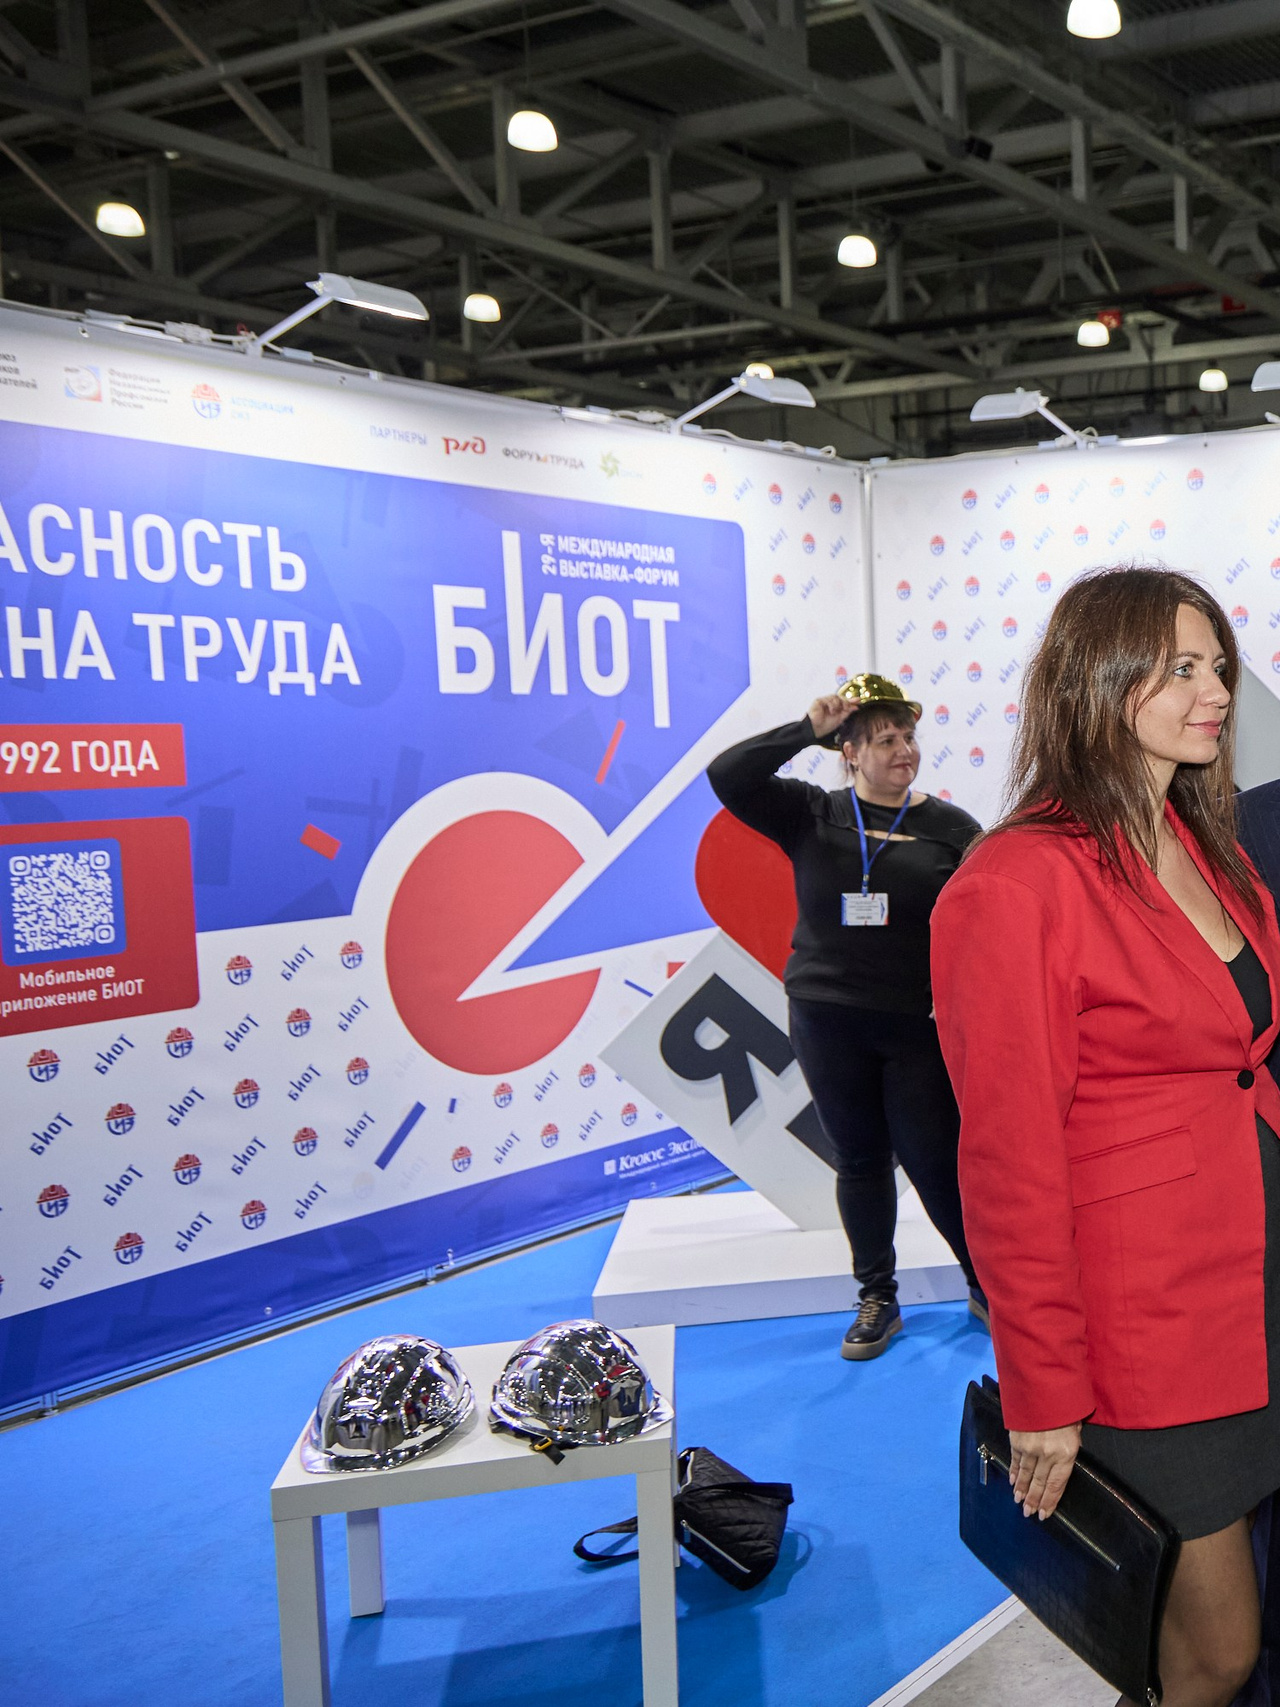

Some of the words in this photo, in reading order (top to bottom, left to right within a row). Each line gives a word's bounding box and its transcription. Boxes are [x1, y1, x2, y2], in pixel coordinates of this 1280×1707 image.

[369, 424, 428, 446] ПАРТНЕРЫ
[558, 534, 675, 564] МЕЖДУНАРОДНАЯ
[559, 560, 680, 587] ВЫСТАВКА-ФОРУМ
[432, 530, 680, 728] БИОТ
[0, 606, 116, 681] НА
[132, 612, 362, 697] ТРУДА
[71, 740, 160, 777] ГОДА
[19, 965, 116, 989] Мобильное
[281, 945, 314, 981] БИОТ
[101, 978, 145, 1000] БИОТ
[224, 1014, 259, 1052] БИОТ
[338, 997, 369, 1032] БИОТ
[94, 1035, 134, 1075] БИОТ
[288, 1065, 321, 1101] БИОТ
[167, 1087, 205, 1126] БИОТ
[30, 1113, 72, 1156] БИОТ
[344, 1112, 375, 1148] БИОТ
[231, 1137, 266, 1175] БИОТ
[103, 1165, 143, 1206] БИОТ
[294, 1182, 327, 1219] БИОТ
[175, 1212, 212, 1252] БИОТ
[39, 1246, 82, 1290] БИОТ
